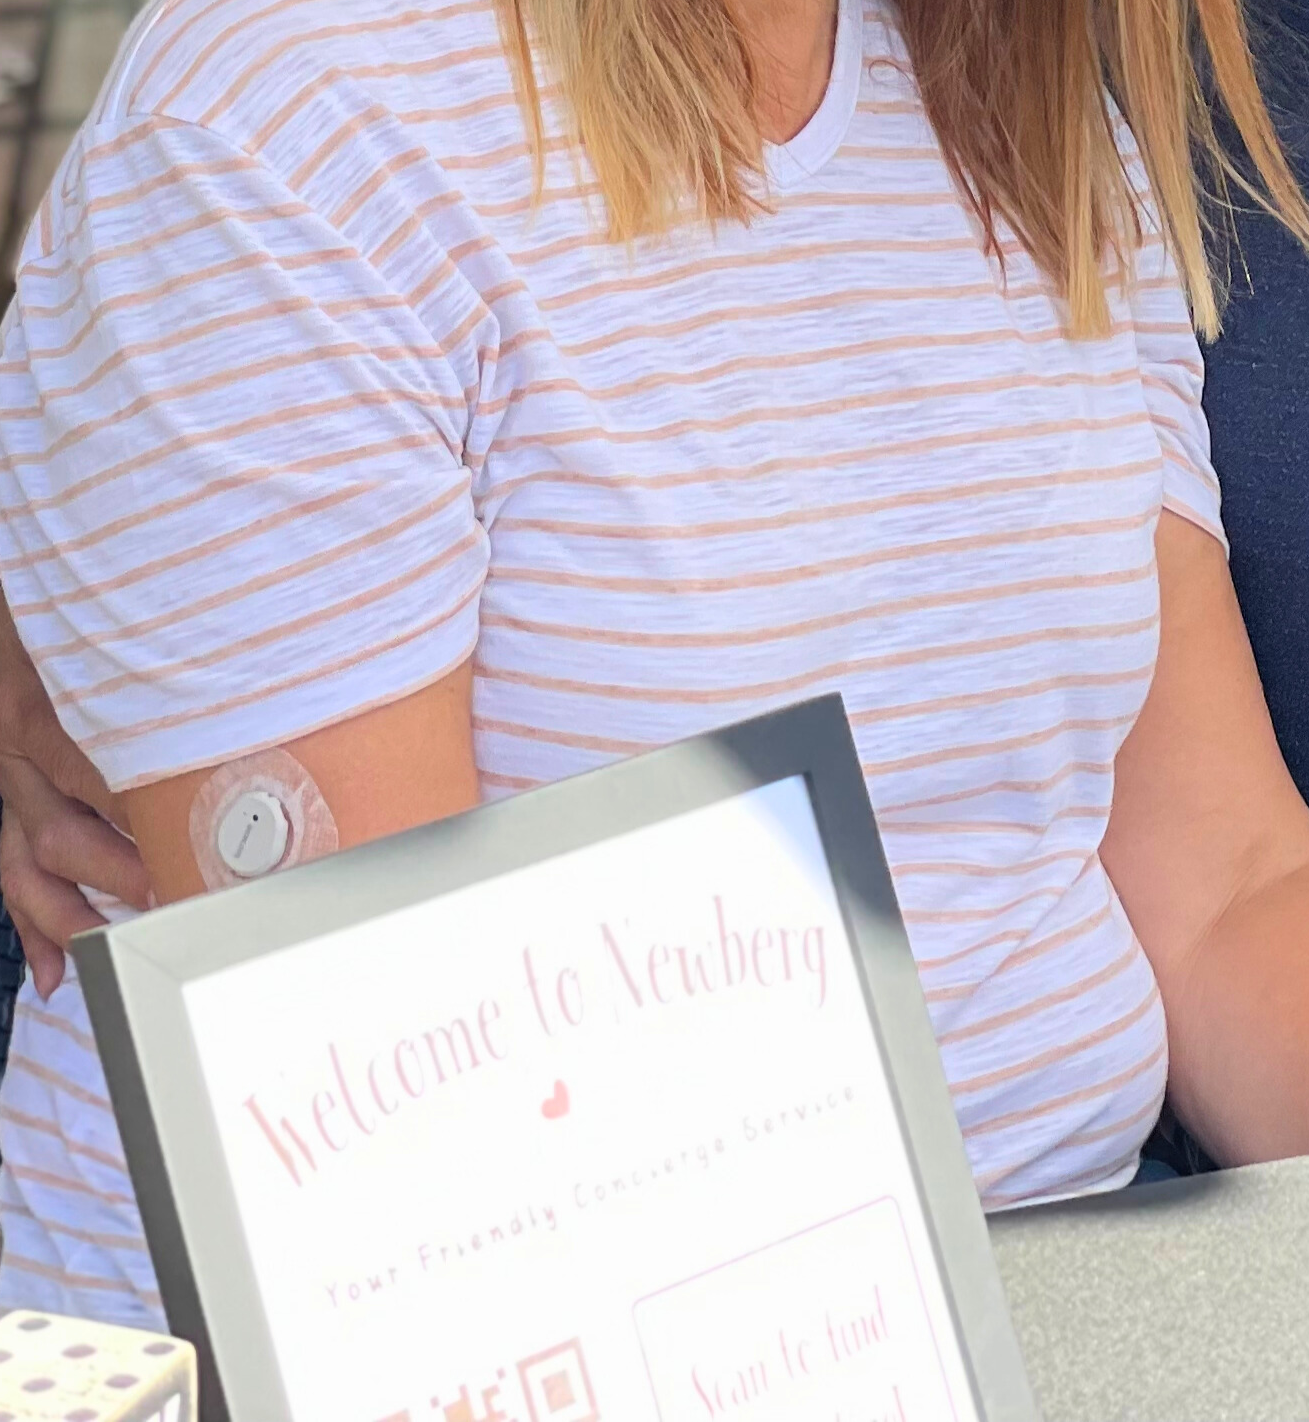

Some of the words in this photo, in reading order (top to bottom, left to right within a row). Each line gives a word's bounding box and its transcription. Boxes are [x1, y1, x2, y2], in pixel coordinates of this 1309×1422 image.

[242, 998, 507, 1188] Welcome
[521, 944, 585, 1037] to
[598, 893, 829, 1014] Newberg
[325, 1265, 399, 1309] Your
[416, 1203, 560, 1272] Friendly
[571, 1134, 727, 1211] Concierge
[741, 1084, 857, 1142] Service
